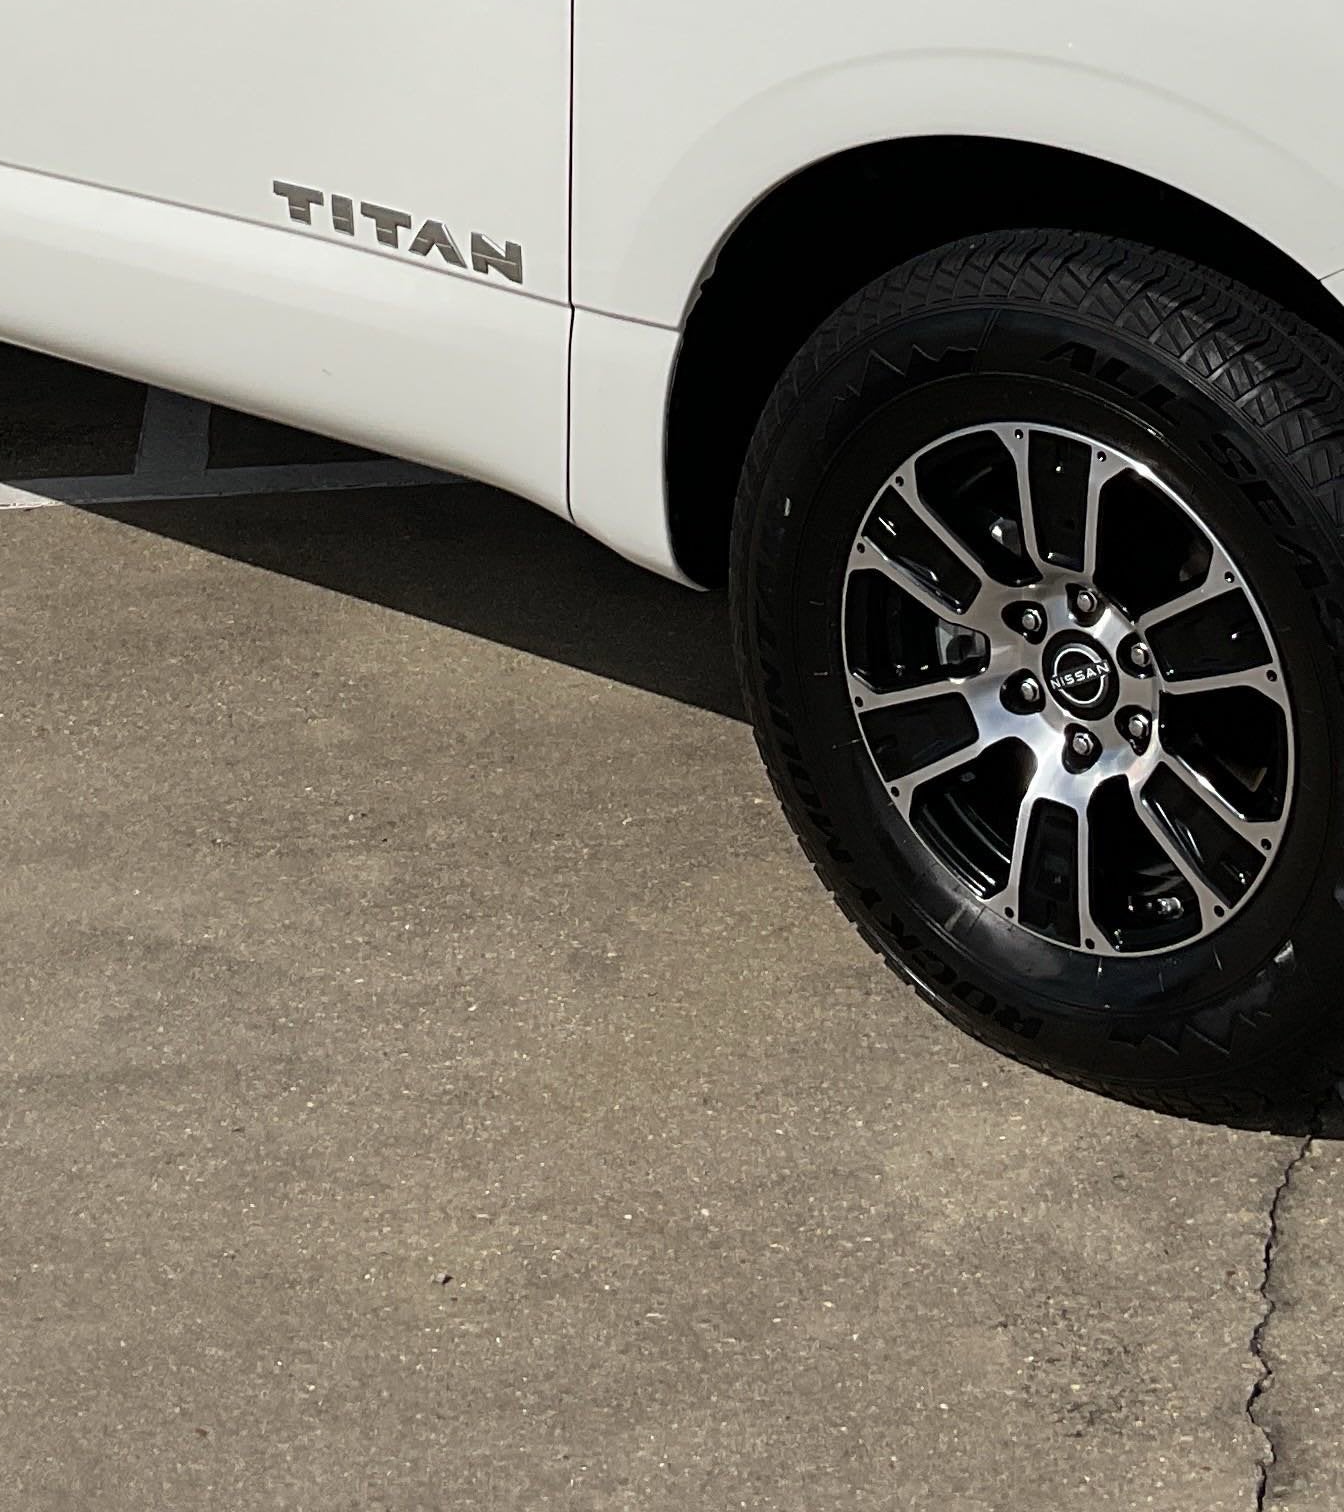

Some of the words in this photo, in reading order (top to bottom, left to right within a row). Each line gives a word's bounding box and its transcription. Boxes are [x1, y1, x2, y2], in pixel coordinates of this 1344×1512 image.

[273, 180, 524, 285] TITAN
[1040, 340, 1184, 426] ALL
[1050, 662, 1111, 690] NISSAN
